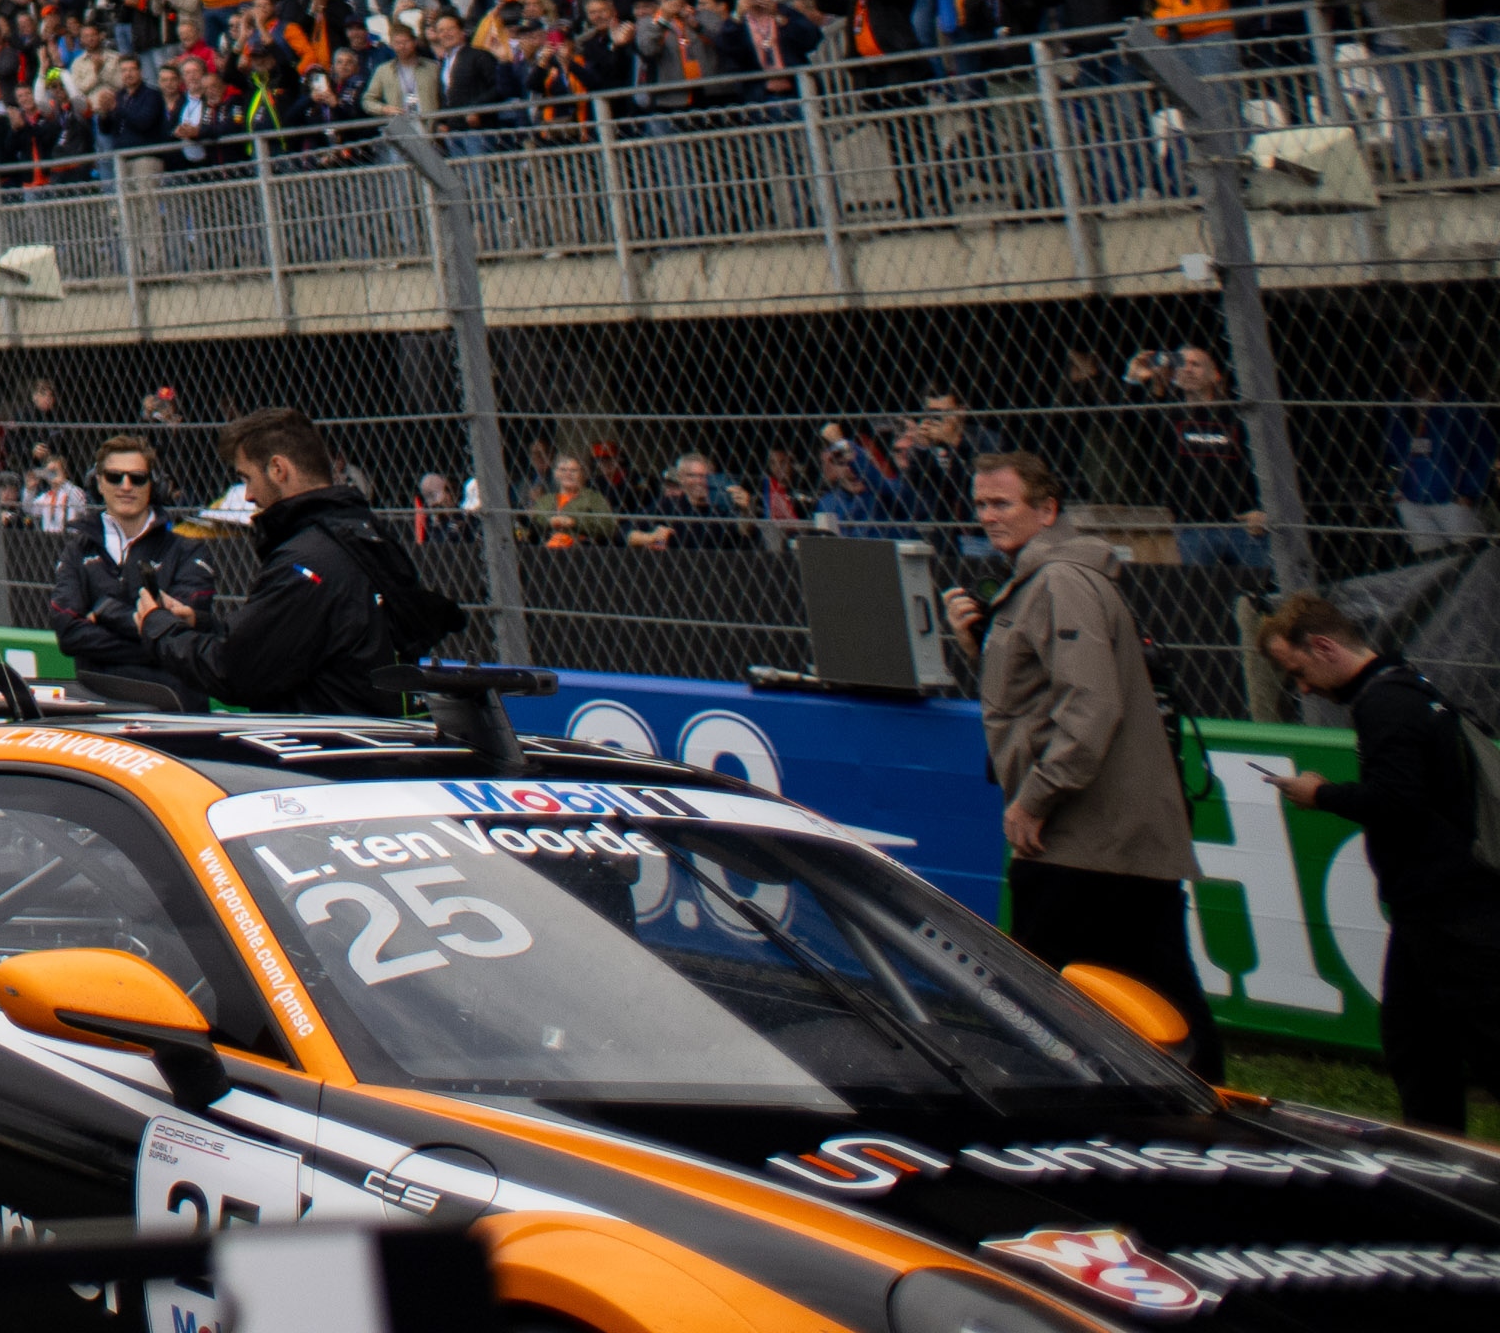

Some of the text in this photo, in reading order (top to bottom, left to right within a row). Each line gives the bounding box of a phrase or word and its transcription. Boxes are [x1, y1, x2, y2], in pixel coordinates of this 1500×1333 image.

[18, 730, 66, 751] TEN
[61, 734, 165, 777] VOORDE
[437, 780, 638, 816] Mobil
[254, 818, 668, 886] L. ten Voorde
[199, 846, 315, 1040] www.porsche.com/pmsc
[295, 865, 534, 986] 25
[148, 1149, 180, 1166] SUPERCUP
[151, 1140, 169, 1153] MOBIL
[153, 1123, 227, 1153] PORSCHE
[959, 1139, 1499, 1185] uniserver
